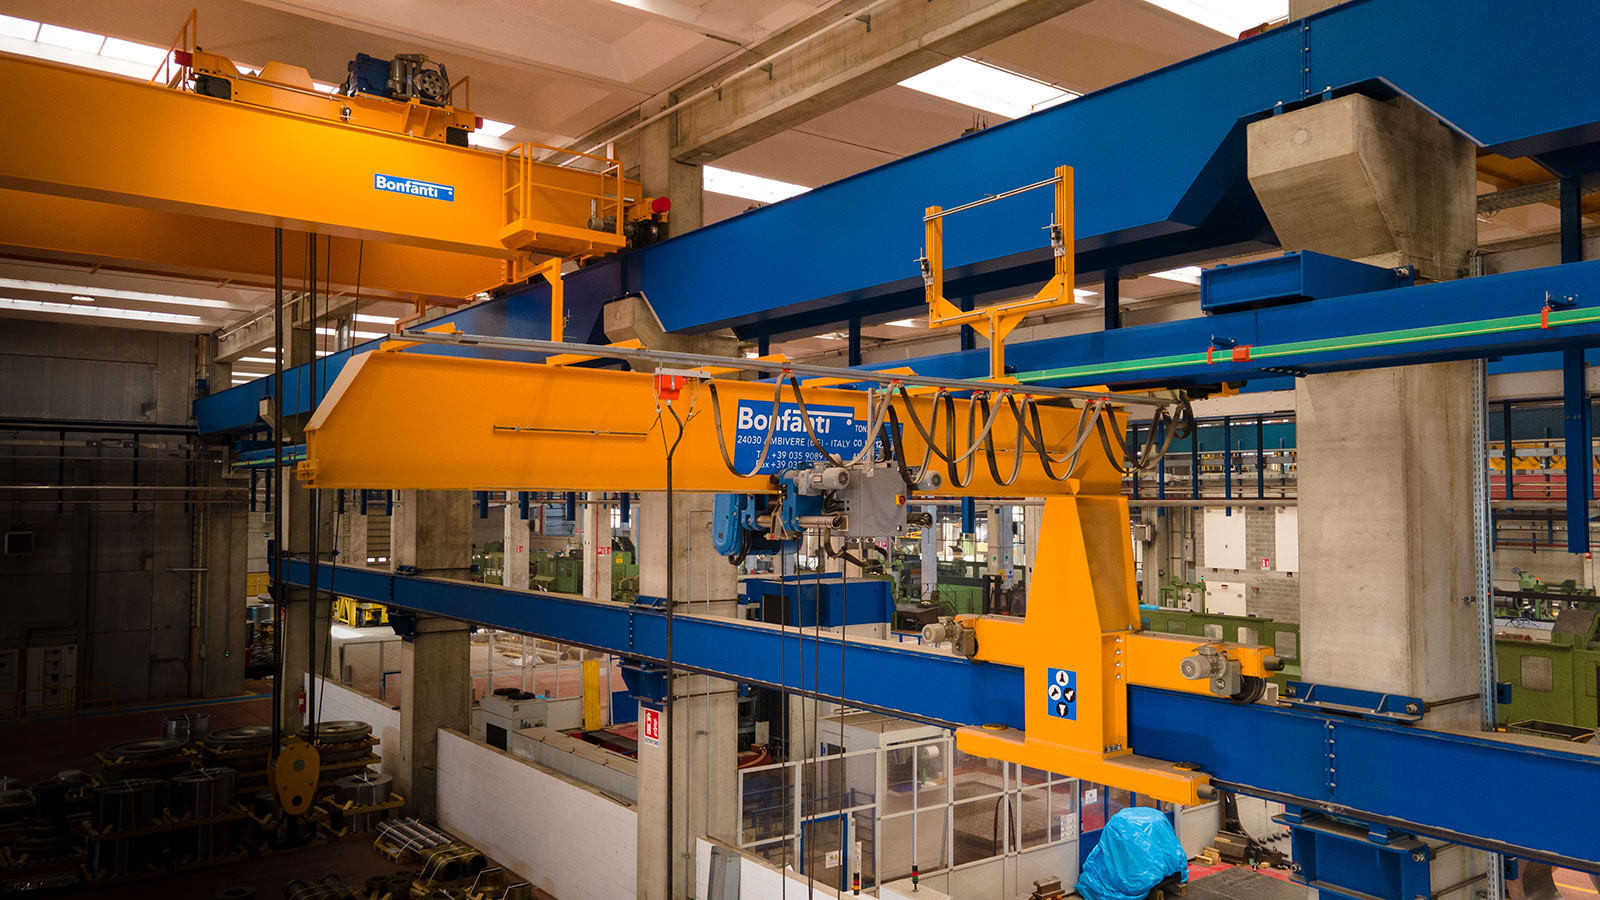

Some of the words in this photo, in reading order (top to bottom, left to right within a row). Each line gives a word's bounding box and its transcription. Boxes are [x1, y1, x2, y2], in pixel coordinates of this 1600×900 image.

[376, 175, 438, 198] Bonfanti
[738, 406, 830, 434] Bonfanti
[737, 434, 762, 445] 24030
[830, 439, 851, 448] ITALY
[771, 450, 787, 460] +39
[788, 451, 803, 460] 035
[771, 460, 786, 469] +39
